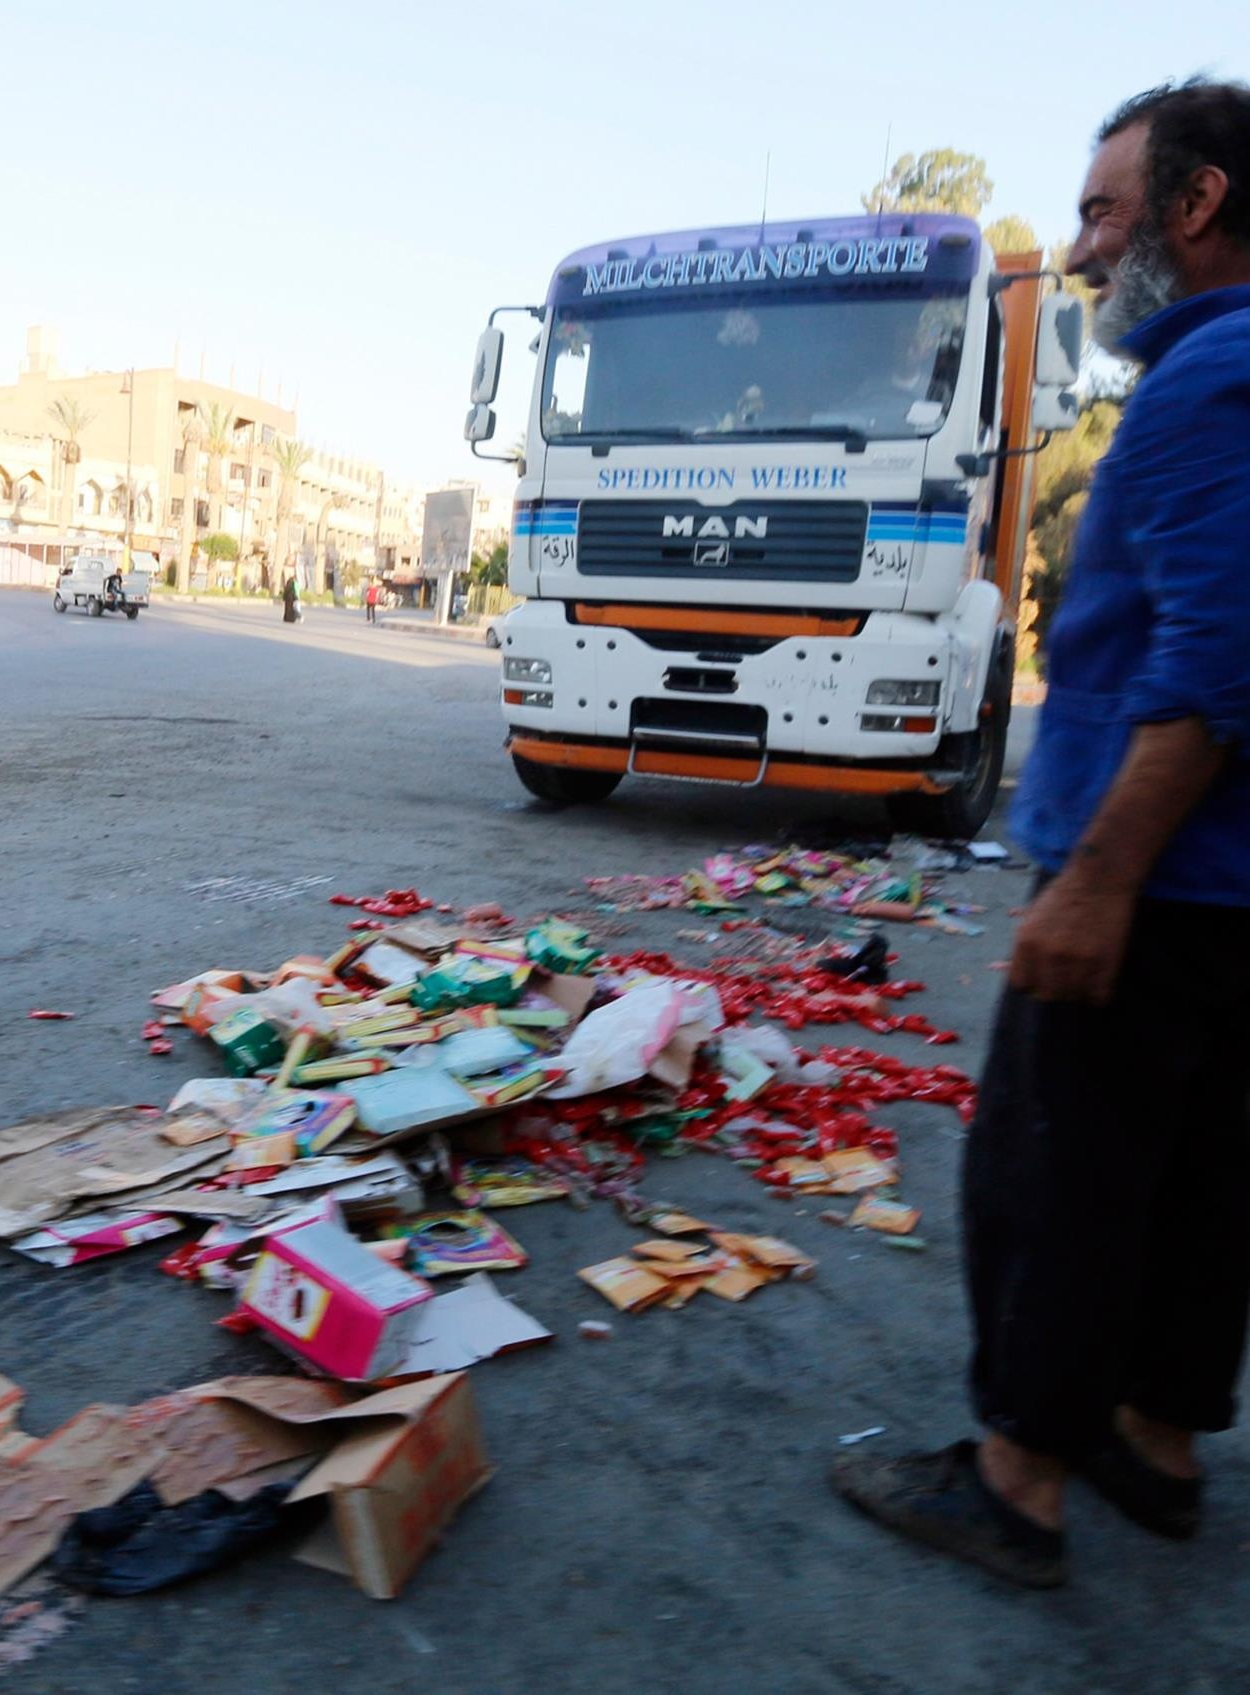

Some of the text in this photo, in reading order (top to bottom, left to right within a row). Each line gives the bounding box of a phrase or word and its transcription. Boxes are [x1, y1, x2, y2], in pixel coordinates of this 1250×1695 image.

[583, 237, 928, 295] MILCHTRANSPORTE
[598, 466, 848, 490] SPEDITION WEBER
[662, 515, 768, 538] MAN
[543, 535, 907, 579] بلدية الرقة
